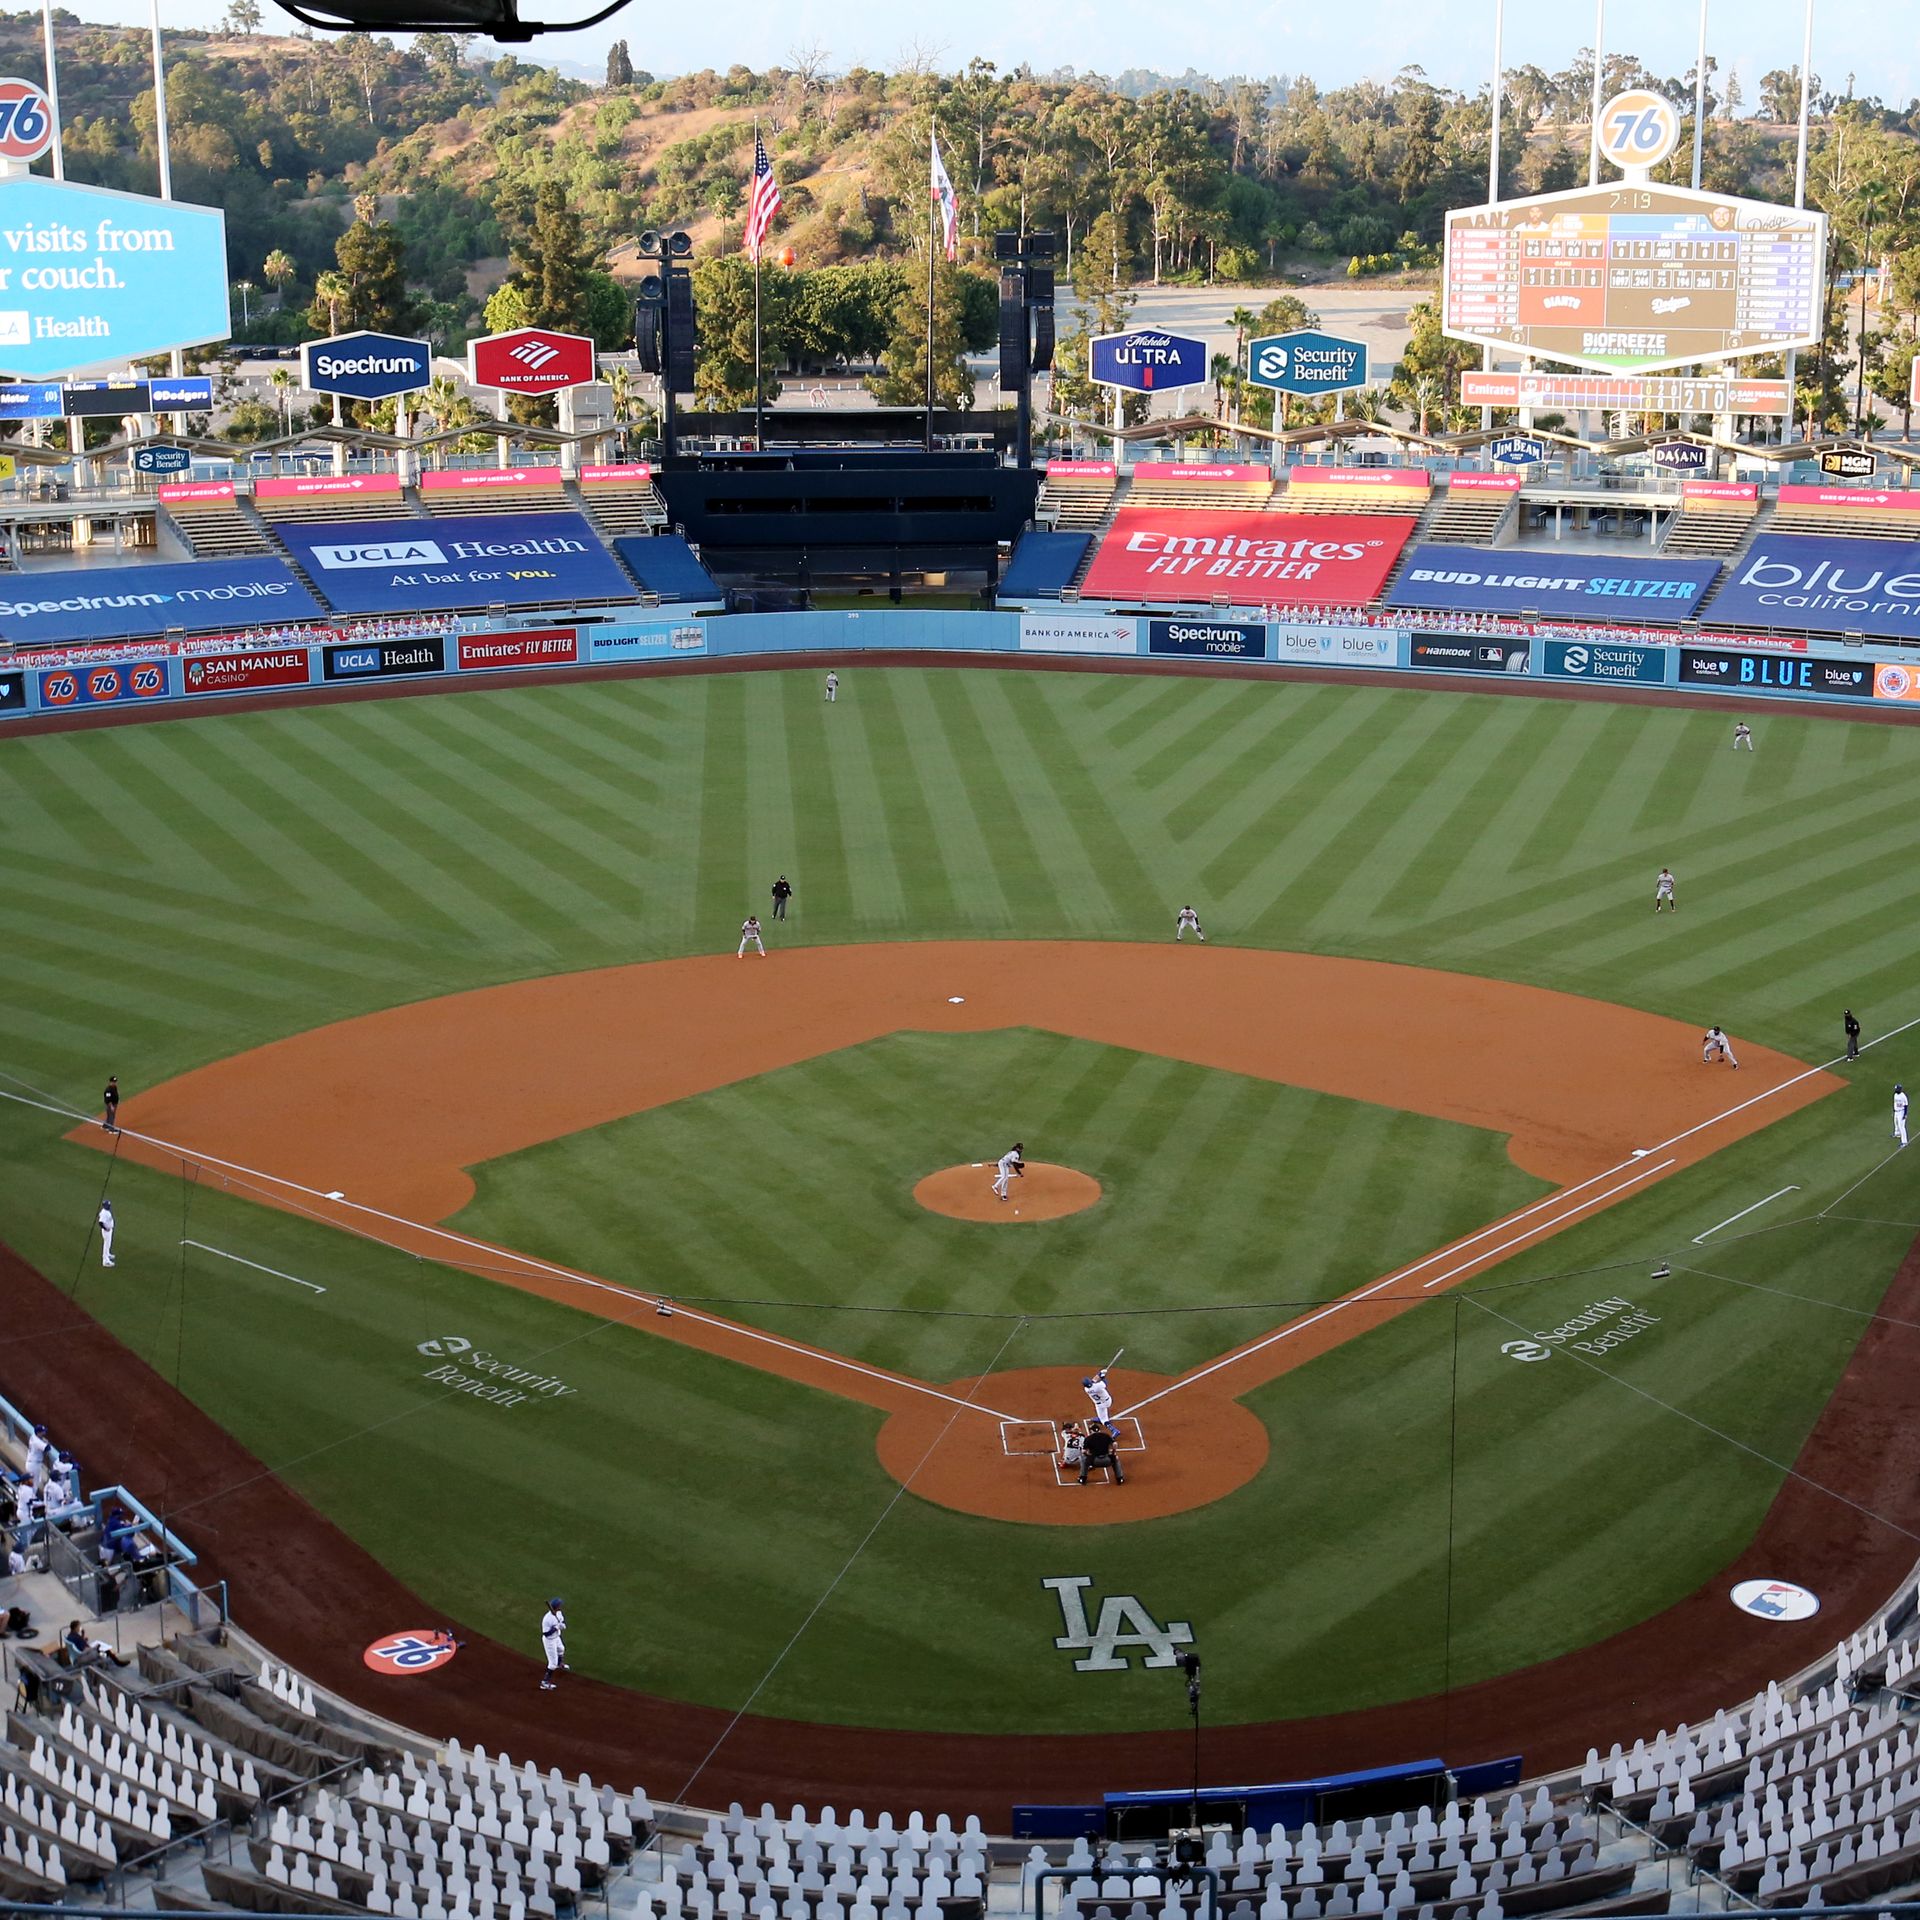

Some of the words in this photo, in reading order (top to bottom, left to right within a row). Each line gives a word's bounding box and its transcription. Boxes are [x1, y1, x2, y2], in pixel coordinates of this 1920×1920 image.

[1611, 106, 1664, 150] 76
[1611, 192, 1651, 208] 7:19
[4, 220, 87, 252] visits
[96, 219, 174, 252] from
[21, 257, 126, 291] couch.
[1544, 296, 1580, 310] GIANTS
[1651, 296, 1691, 314] Dodgers
[34, 315, 111, 338] Health
[1125, 335, 1170, 348] Michelob
[1115, 348, 1182, 365] ULTRA
[1294, 347, 1357, 367] Security
[317, 355, 414, 380] Spectrum
[1294, 364, 1350, 382] Benefit
[534, 374, 570, 382] AMERICA
[154, 390, 208, 402] @Dodgers
[1467, 383, 1516, 396] Emirates
[1658, 384, 1664, 396] 2
[1756, 390, 1787, 399] MANUEL
[1672, 398, 1675, 409] 1
[1684, 390, 1694, 409] 2
[1701, 390, 1706, 410] 1
[1714, 390, 1724, 410] 0
[156, 452, 186, 462] Security
[1494, 442, 1512, 459] JIM
[1513, 439, 1540, 460] BEAM
[1656, 450, 1704, 465] DASANI
[156, 460, 182, 468] Benefit
[1842, 456, 1872, 468] MGM
[462, 474, 478, 483] BANK
[479, 474, 488, 483] OF
[488, 474, 514, 483] AMERICA
[584, 468, 600, 477] BANK
[601, 468, 610, 477] OF
[610, 468, 636, 477] AMERICA
[297, 482, 313, 490] BANK
[314, 482, 323, 490] OF
[324, 482, 351, 490] AMERICA
[1479, 478, 1505, 486] AMERICA
[163, 490, 179, 498] BANK
[180, 490, 189, 498] OF
[190, 490, 218, 498] AMERICA
[1712, 488, 1740, 496] AMERICA
[1820, 494, 1836, 502] BANK
[1838, 494, 1846, 502] OF
[1846, 494, 1874, 502] AMERICA
[332, 547, 428, 563] UCLA
[448, 538, 588, 560] Health
[1125, 531, 1365, 561] Emirates
[1147, 557, 1204, 575] FLY
[1205, 559, 1320, 580] BETTER
[391, 574, 417, 588] At
[420, 571, 463, 586] bat
[467, 569, 501, 583] for
[506, 569, 557, 583] you.
[1409, 569, 1482, 586] BUD
[1482, 574, 1584, 591] LIGHT
[1585, 577, 1697, 600] SELTZER
[1739, 556, 1920, 598] blue
[0, 592, 161, 617] Spectrum
[594, 638, 612, 648] BUD
[614, 636, 640, 646] LIGHT
[640, 634, 667, 646] SELTZER
[1025, 628, 1050, 638] BANK
[1053, 628, 1065, 638] OF
[1067, 630, 1110, 640] AMERICA
[1168, 624, 1240, 644] Spectrum
[1286, 634, 1317, 648] blue
[1693, 633, 1739, 645] Emirates
[1748, 636, 1795, 649] Emirates
[462, 641, 521, 659] Emirates
[526, 640, 540, 654] FLY
[541, 638, 572, 654] BETTER
[1206, 642, 1241, 654] mobile
[1343, 636, 1374, 652] blue
[206, 660, 236, 675] SAN
[240, 654, 304, 672] MANUEL
[339, 654, 375, 669] UCLA
[384, 648, 434, 667] Health
[1594, 648, 1644, 665] Security
[1692, 658, 1717, 670] blue
[1594, 662, 1638, 678] Benefit
[1825, 668, 1850, 680] blue
[49, 677, 74, 698] 76
[92, 673, 118, 694] 76
[134, 668, 160, 689] 76
[206, 674, 245, 685] CASINO
[1534, 1296, 1635, 1344] Security
[1571, 1315, 1662, 1357] Benefit
[458, 1351, 578, 1398] Security
[421, 1364, 528, 1408] Benefit
[1042, 1575, 1194, 1672] LA
[373, 1637, 452, 1668] 76
